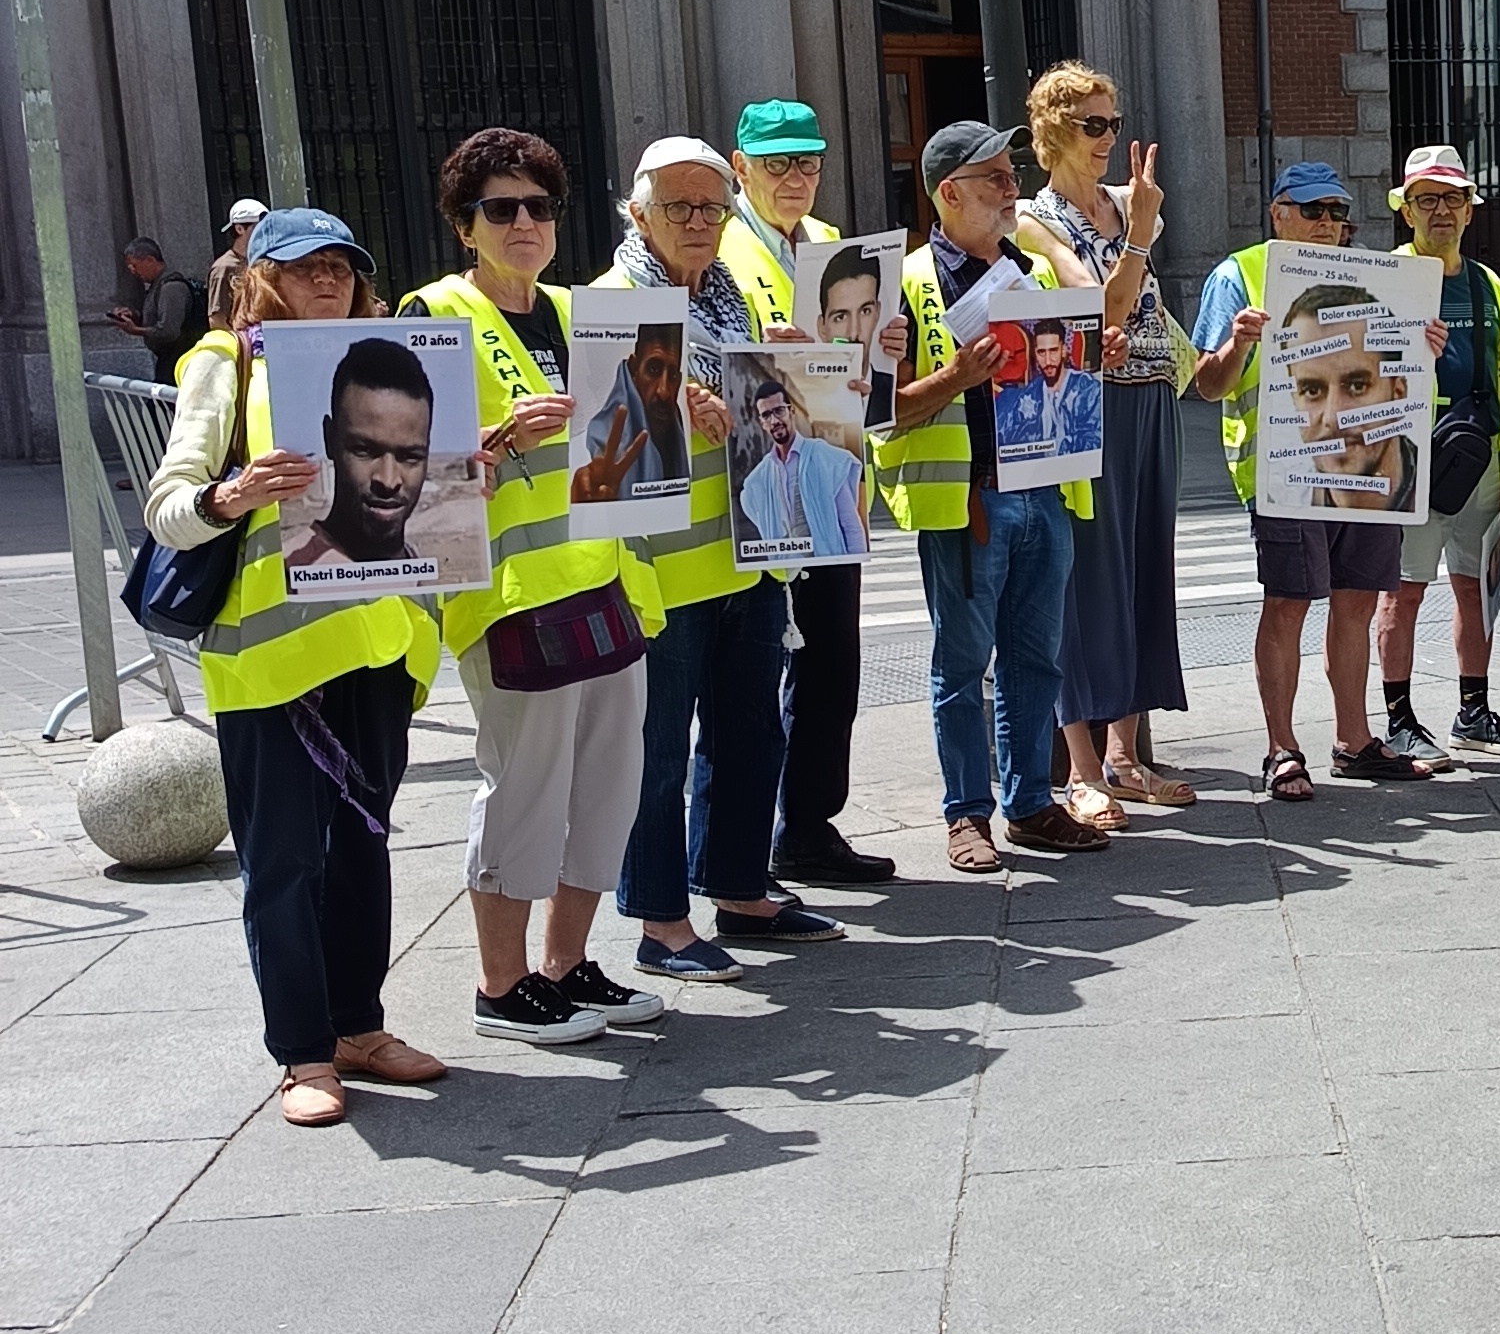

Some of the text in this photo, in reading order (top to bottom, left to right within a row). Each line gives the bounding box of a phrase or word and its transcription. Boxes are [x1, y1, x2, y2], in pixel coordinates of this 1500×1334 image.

[1298, 249, 1399, 268] Mohamed Lamine Haddi
[1280, 265, 1318, 277] Condena
[1325, 270, 1336, 280] 25
[1337, 272, 1358, 283] años
[1321, 310, 1345, 321] Dolor
[1346, 306, 1379, 319] espalda
[411, 334, 459, 347] 20 años
[573, 329, 604, 340] Cadena
[1366, 336, 1411, 347] septicemia
[1300, 346, 1322, 358] Mala
[481, 329, 533, 399] SAHA
[808, 363, 848, 373] 6 meses
[1268, 382, 1296, 393] Asma.
[1361, 406, 1403, 422] infectado,
[1403, 401, 1428, 413] dolor,
[1269, 416, 1308, 425] Enuresis.
[1366, 421, 1414, 442] Aislamiento
[1269, 441, 1344, 459] Acidez estomacal.
[1288, 474, 1386, 489] Sin tratamiento médico
[743, 544, 777, 555] Brahim
[293, 563, 435, 582] Khatri Boujamaa Dada
